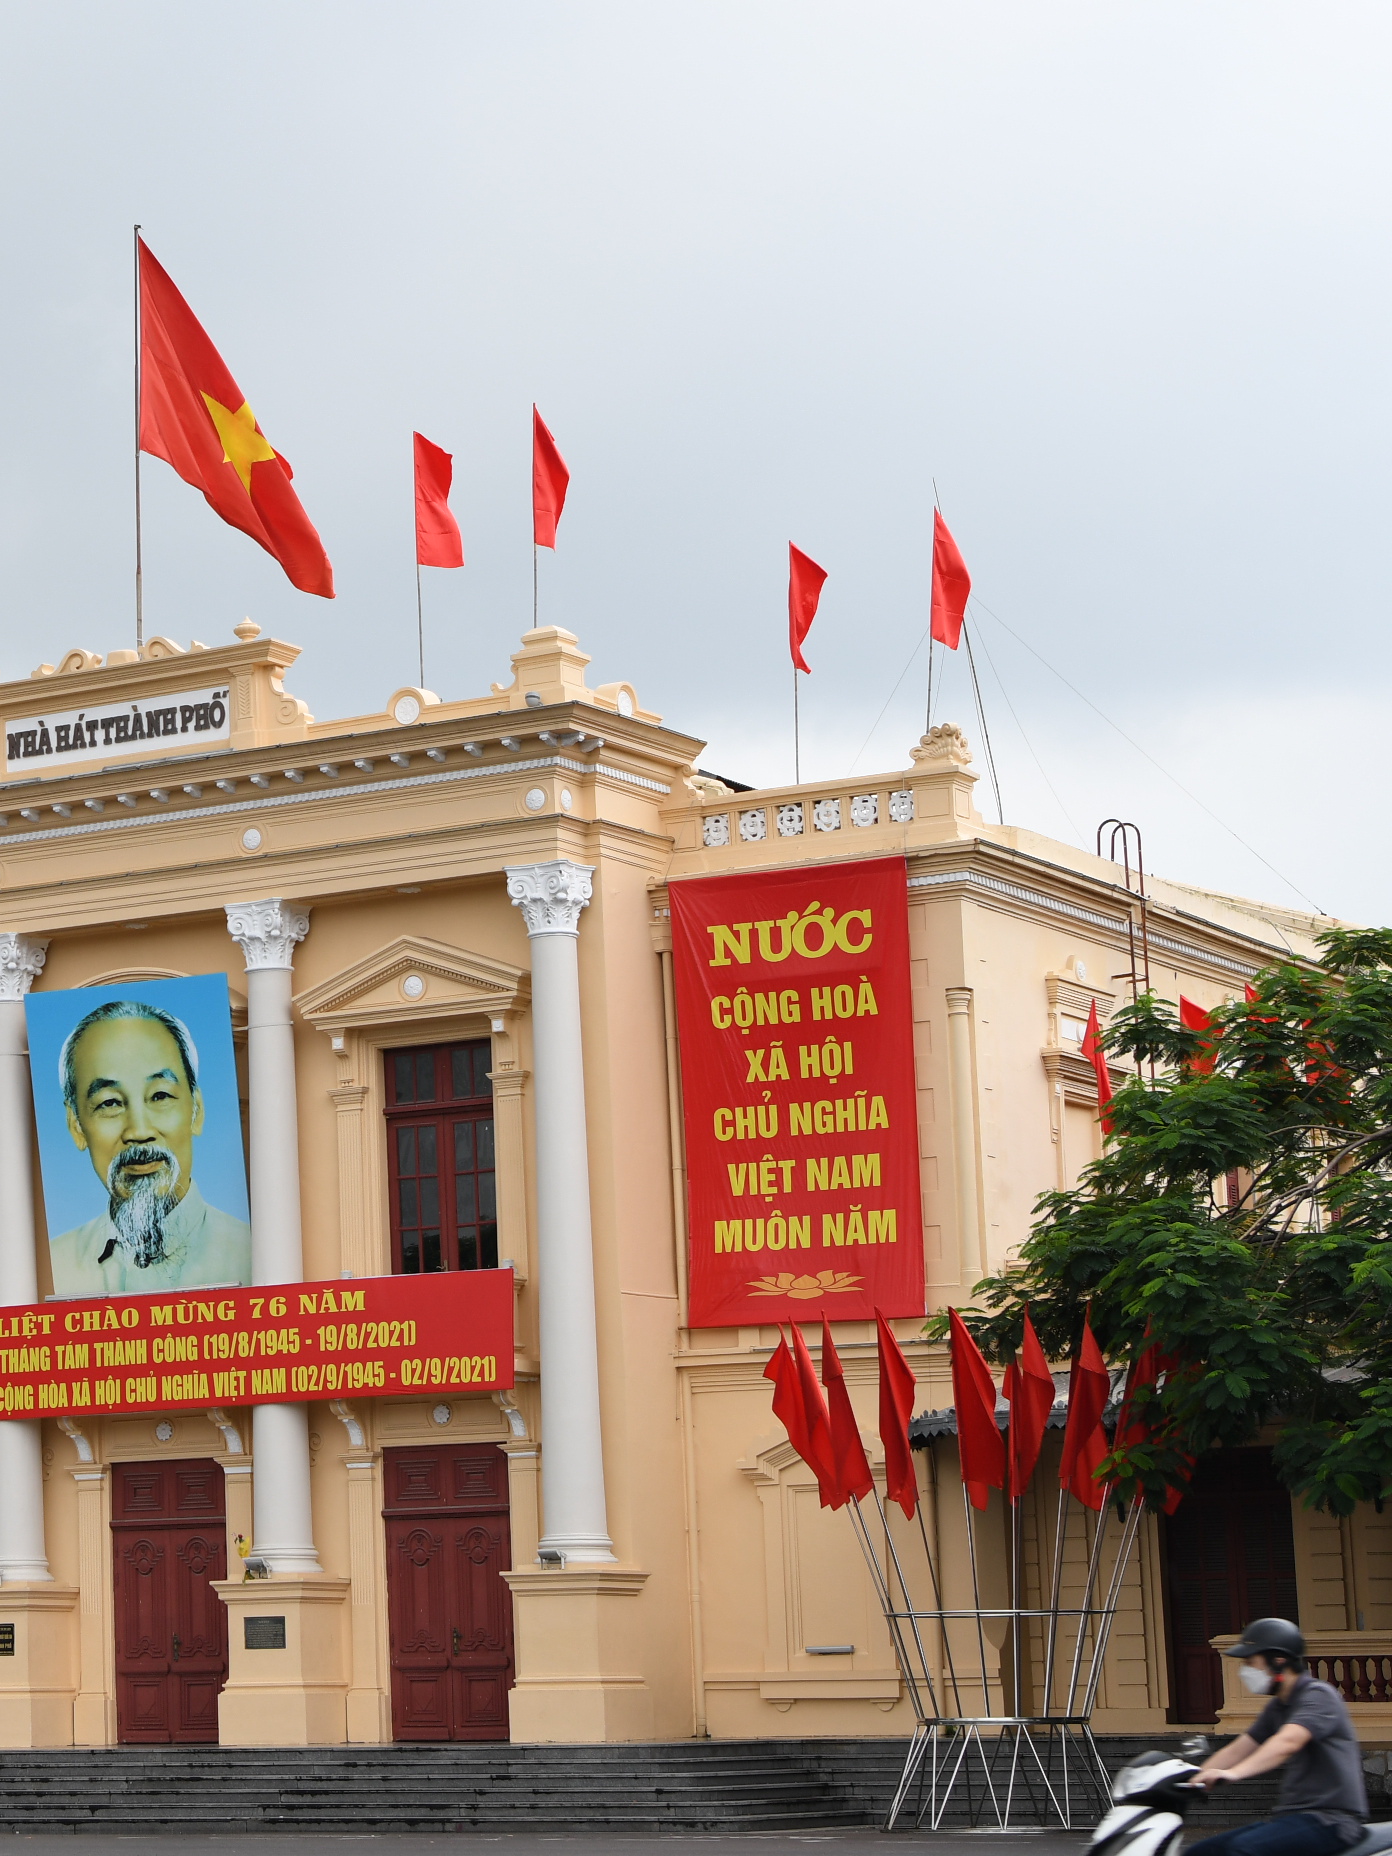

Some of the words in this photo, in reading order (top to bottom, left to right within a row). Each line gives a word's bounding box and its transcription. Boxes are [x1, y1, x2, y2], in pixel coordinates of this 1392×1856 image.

[7, 721, 52, 760] NHÀ
[55, 714, 98, 752] HÁT
[101, 705, 177, 745] THÀNH
[180, 690, 229, 732] PHỐ
[707, 901, 872, 966] NƯỚC
[711, 987, 800, 1034] CỘNG
[811, 976, 878, 1020] HOÀ
[745, 1041, 790, 1082] XÃ
[799, 1036, 853, 1083] HỘI
[714, 1091, 778, 1141] CHỦ
[789, 1090, 889, 1136] NGHĨA
[728, 1154, 795, 1202] VIỆT
[807, 1153, 881, 1191] NAM
[715, 1210, 810, 1253] MUÔN
[823, 1204, 896, 1247] NĂM
[65, 1306, 139, 1332] CHÀO
[150, 1300, 236, 1326] MỪNG
[250, 1297, 286, 1318] 76
[299, 1289, 365, 1314] NĂM
[0, 1344, 50, 1373] THÁNG
[55, 1341, 89, 1369] TÁM
[94, 1338, 147, 1367] THÀNH
[153, 1333, 198, 1363] CÔNG
[204, 1328, 300, 1359] (19/8/1945
[317, 1320, 416, 1351] 19/8/2021)
[39, 1380, 68, 1408] HÒA
[72, 1378, 91, 1406] XÃ
[95, 1375, 120, 1409] HỘI
[126, 1371, 156, 1403] CHỦ
[162, 1370, 209, 1400] NGHĨA
[213, 1367, 246, 1400] VIỆT
[252, 1368, 286, 1395] NAM
[292, 1361, 384, 1392] (02/9/1945
[401, 1356, 496, 1385] 02/9/2021)
